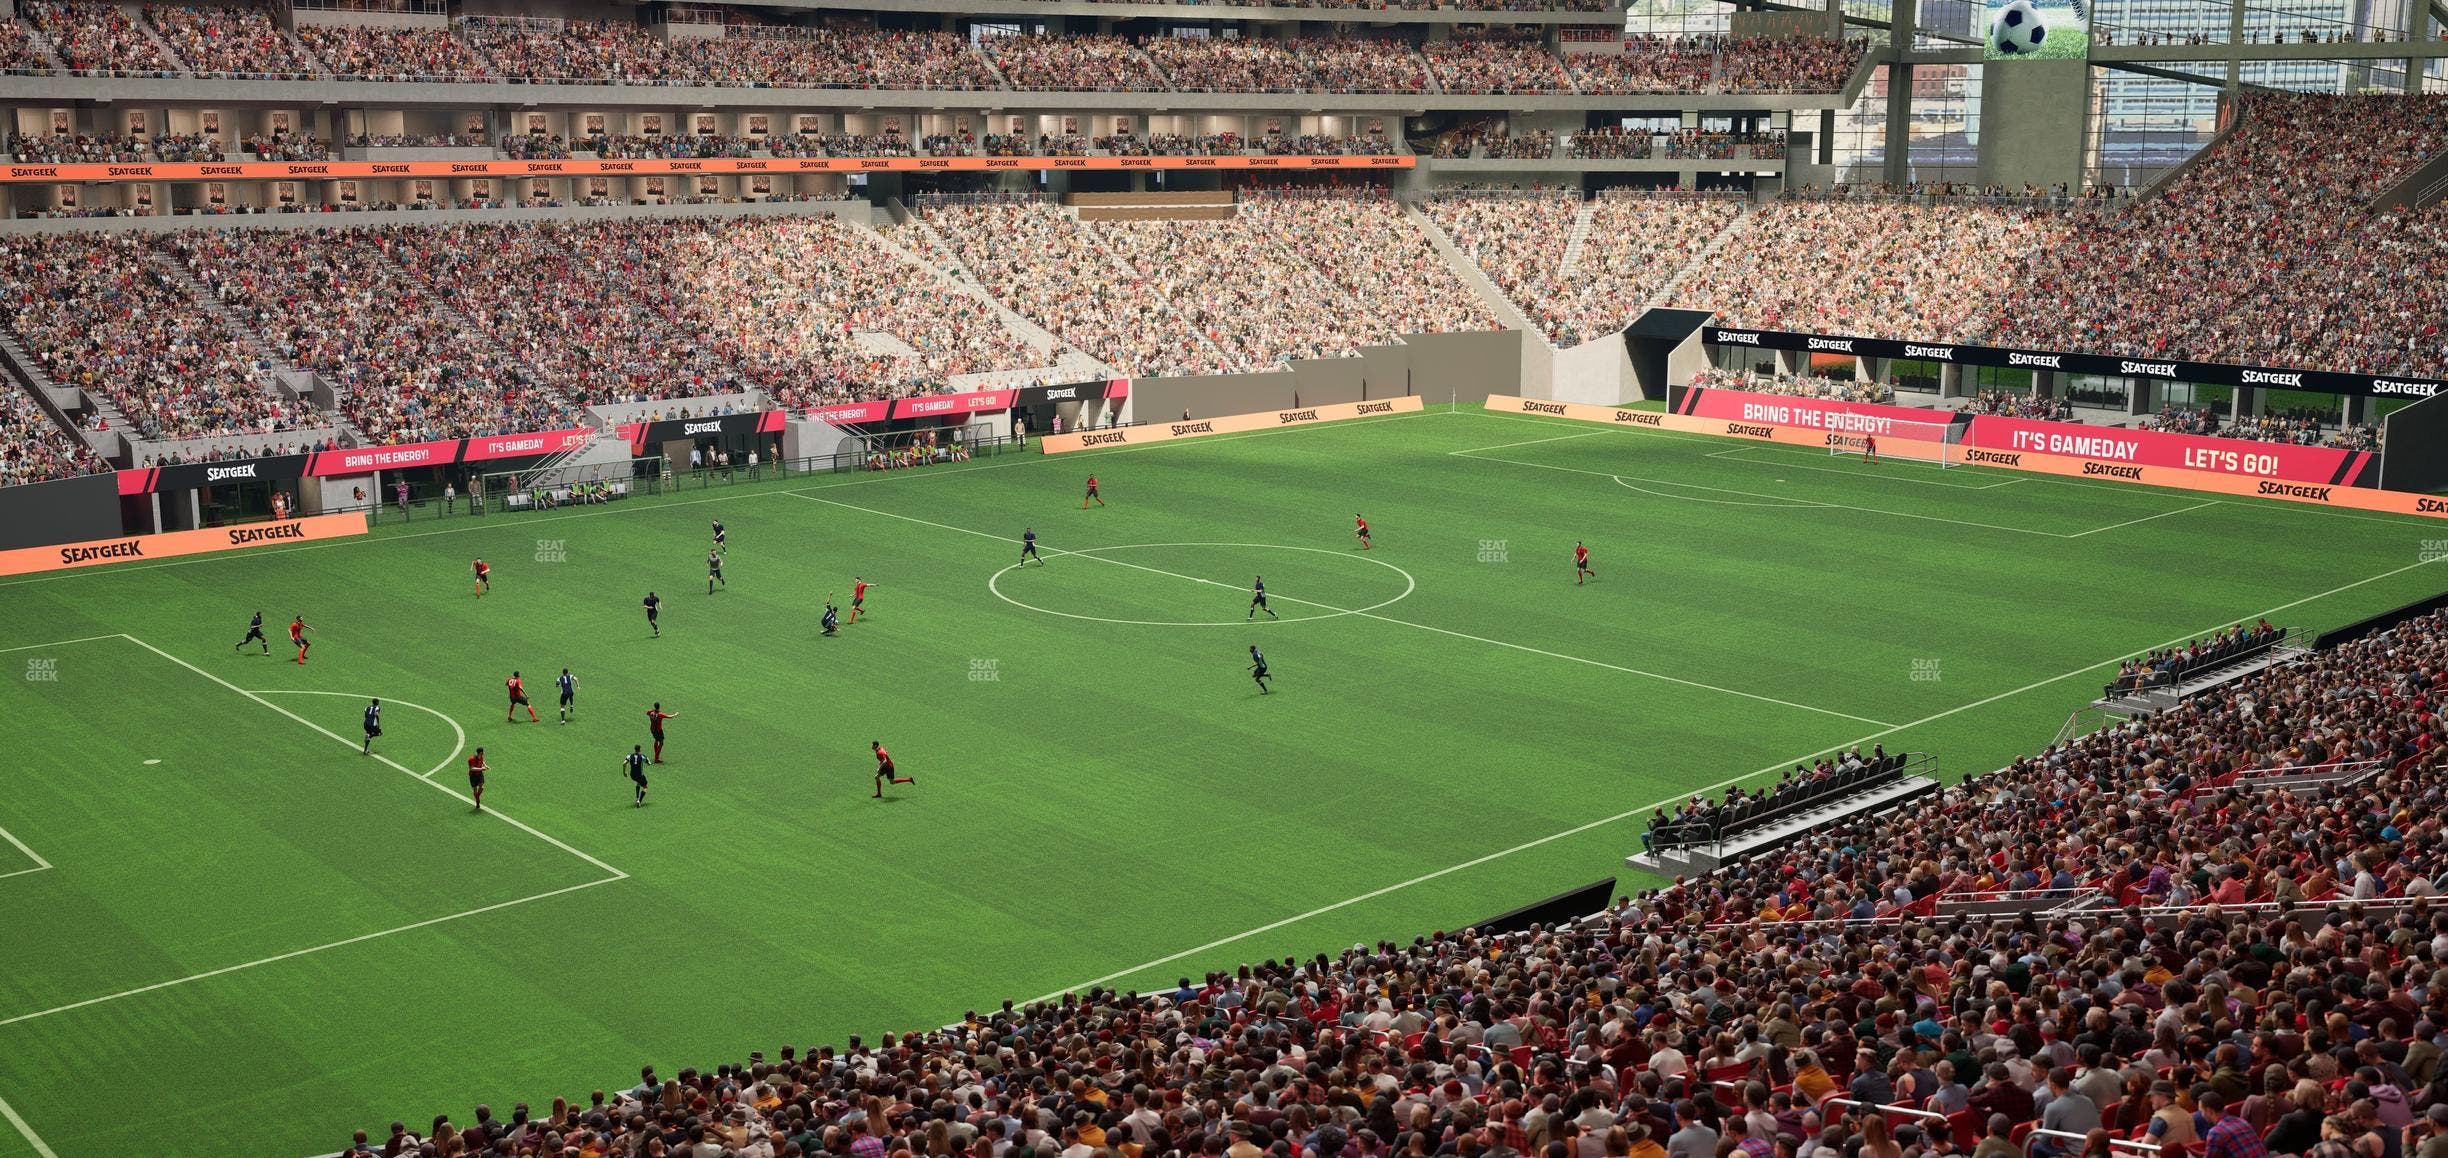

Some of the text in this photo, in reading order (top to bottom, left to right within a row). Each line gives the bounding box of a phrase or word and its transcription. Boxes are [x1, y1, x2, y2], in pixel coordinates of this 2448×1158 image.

[451, 163, 488, 172] SEATGEEK
[527, 163, 563, 172] SEATGEEK
[600, 162, 634, 171] SEATGEEK
[669, 161, 702, 170] SEATGEEK
[737, 161, 768, 169] SEATGEEK
[800, 160, 830, 168] SEATGEEK
[861, 160, 890, 168] SEATGEEK
[920, 160, 950, 168] SEATGEEK
[986, 159, 1019, 168] SEATGEEK
[1054, 159, 1087, 167] SEATGEEK
[1121, 159, 1152, 167] SEATGEEK
[1185, 158, 1217, 166] SEATGEEK
[1249, 158, 1279, 166] SEATGEEK
[1311, 157, 1340, 165] SEATGEEK
[1370, 157, 1400, 165] SEATGEEK
[11, 167, 58, 177] SEATGEEK
[108, 166, 152, 176] SEATGEEK
[200, 165, 243, 175] SEATGEEK
[288, 165, 328, 174] SEATGEEK
[372, 164, 410, 174] SEATGEEK
[1718, 330, 1760, 344] SEATGEEK
[1807, 337, 1854, 352] SEATGEEK
[1905, 345, 1954, 360] SEATGEEK
[2008, 353, 2061, 369] SEATGEEK
[2120, 361, 2177, 378] SEATGEEK
[2241, 369, 2303, 387] SEATGEEK
[1047, 387, 1077, 400] SEATGEEK
[2372, 379, 2439, 397] SEATGEEK
[924, 399, 955, 412] GAMEDAY
[1357, 401, 1393, 414] SEATGEEK
[1523, 400, 1567, 415] SEATGEEK
[838, 408, 867, 420] ENERGY!
[1279, 409, 1318, 424] SEATGEEK
[1615, 410, 1663, 425] SEATGEEK
[1744, 403, 1891, 434] BRING THE ENERGY!
[685, 420, 722, 436] SEATGEEK
[1172, 422, 1213, 437] SEATGEEK
[1726, 422, 1775, 438] SEATGEEK
[505, 438, 544, 452] GAMEDAY
[1081, 431, 1126, 447] SEATGEEK
[345, 449, 430, 468] BRING THE ENERGY!
[1965, 449, 2021, 467] SEATGEEK
[2013, 431, 2279, 476] IT'S GAMEDAY LET'S GO!
[207, 463, 256, 482] SEATGEEK
[2082, 461, 2143, 480] SEATGEEK
[2257, 481, 2331, 503] SEATGEEK
[229, 522, 305, 545] SEATGEEK
[61, 540, 144, 565] SEATGEEK
